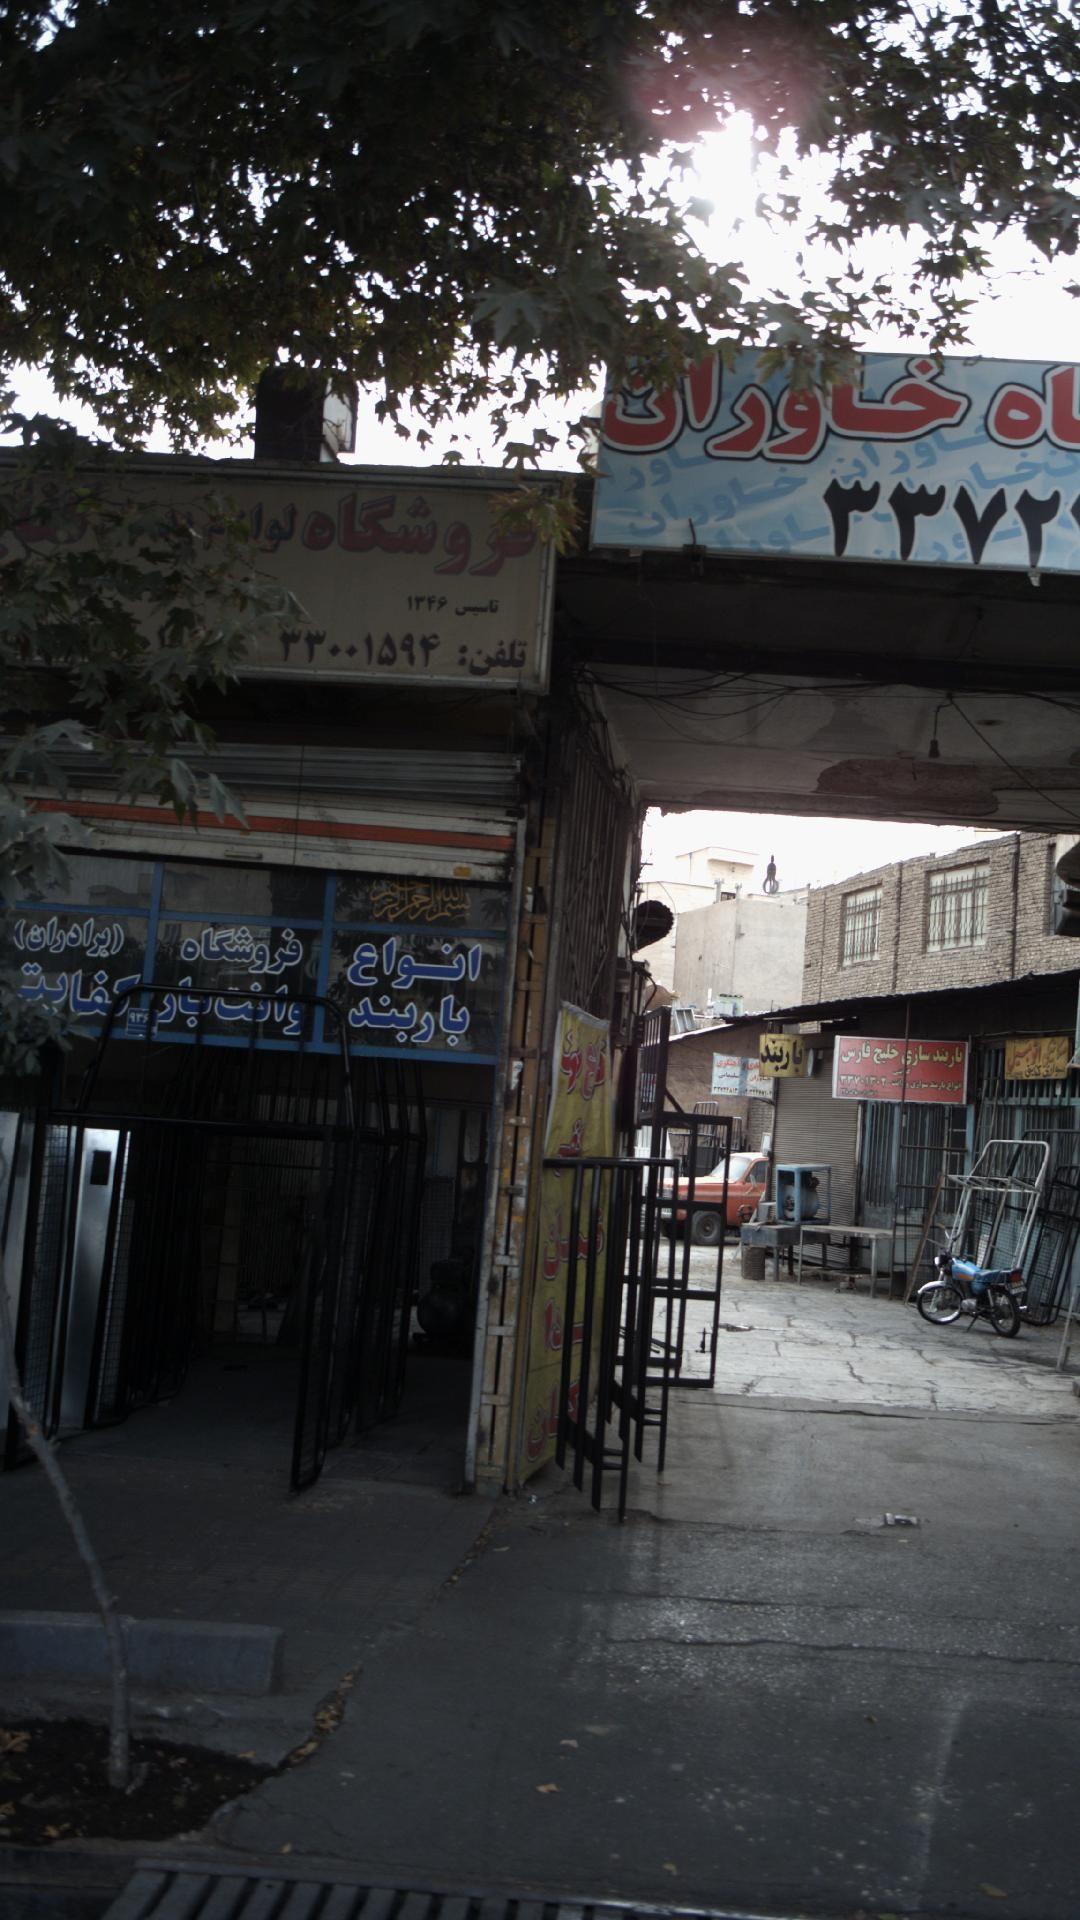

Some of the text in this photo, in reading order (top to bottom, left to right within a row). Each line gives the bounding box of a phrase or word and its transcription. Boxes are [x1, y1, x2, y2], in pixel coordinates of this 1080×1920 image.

[601, 354, 1080, 463] اه خاوران
[302, 494, 538, 577] فروشگاه
[407, 594, 499, 617] تاسیس ۱۳۴۶
[279, 625, 441, 667] ۳۳۰۰۱۵۹۴
[180, 927, 304, 974] فروشگاه
[347, 936, 482, 988] انواع
[17, 962, 141, 1017] کفایت
[761, 1040, 803, 1072] باربند
[841, 1041, 871, 1064] فارس
[873, 1043, 899, 1064] خلیج
